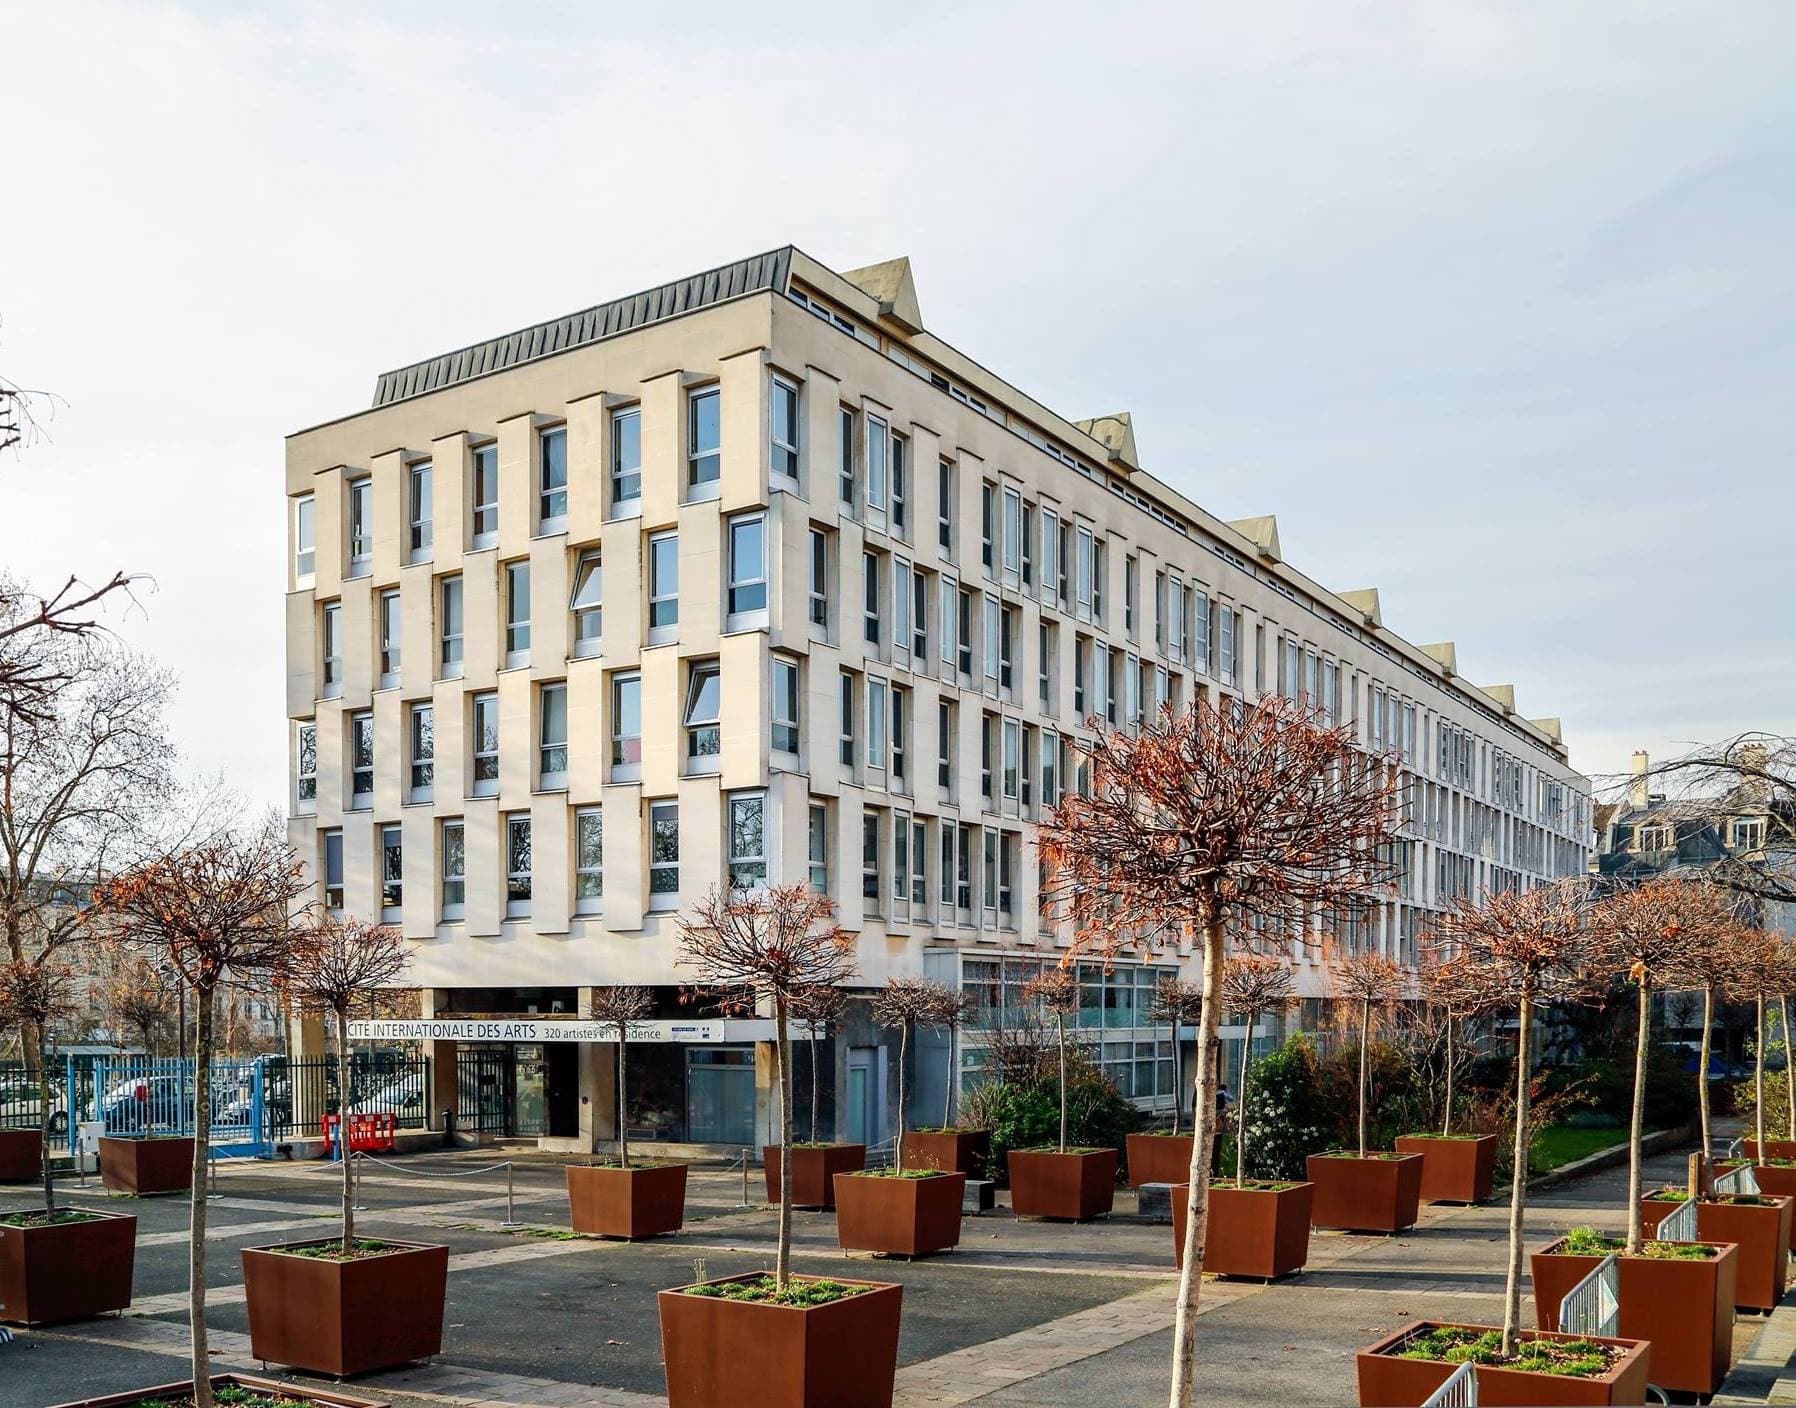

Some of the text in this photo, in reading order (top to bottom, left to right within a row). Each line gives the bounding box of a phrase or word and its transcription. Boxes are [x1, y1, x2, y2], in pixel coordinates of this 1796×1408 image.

[374, 1023, 473, 1038] INTERNATIONALE
[477, 1024, 501, 1038] DES
[504, 1024, 536, 1038] ARTS
[544, 1028, 561, 1039] 320
[563, 1028, 597, 1039] artistes
[599, 1029, 611, 1039] en
[614, 1028, 661, 1039] rsidence
